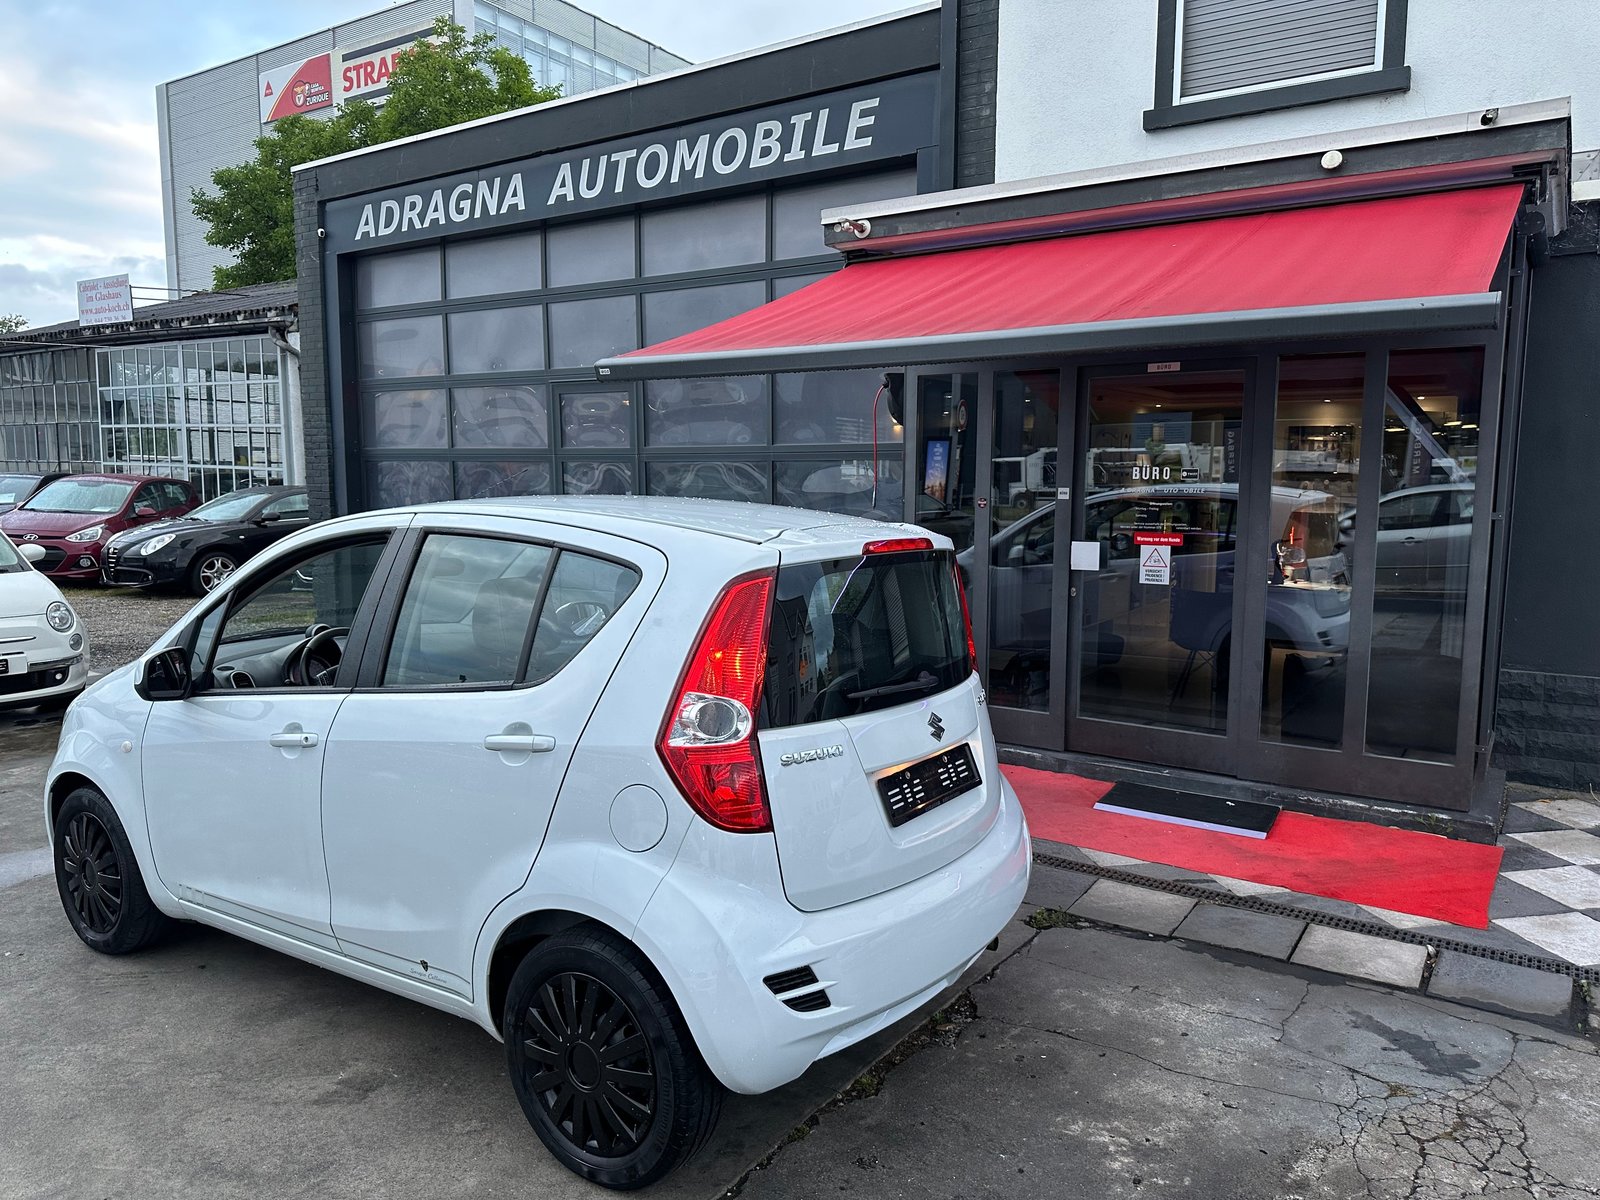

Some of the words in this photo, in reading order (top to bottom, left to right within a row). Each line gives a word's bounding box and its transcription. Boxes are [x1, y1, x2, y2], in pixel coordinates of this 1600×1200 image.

[306, 92, 328, 105] ZURIQUE
[354, 173, 526, 241] ADRAGNA
[546, 97, 880, 205] AUTOMOBILE
[86, 294, 93, 302] im
[95, 290, 122, 301] Glashaus
[80, 302, 130, 314] www.auto-koch.ch
[1132, 464, 1170, 480] BÜRO
[780, 744, 844, 767] SUZUKI
